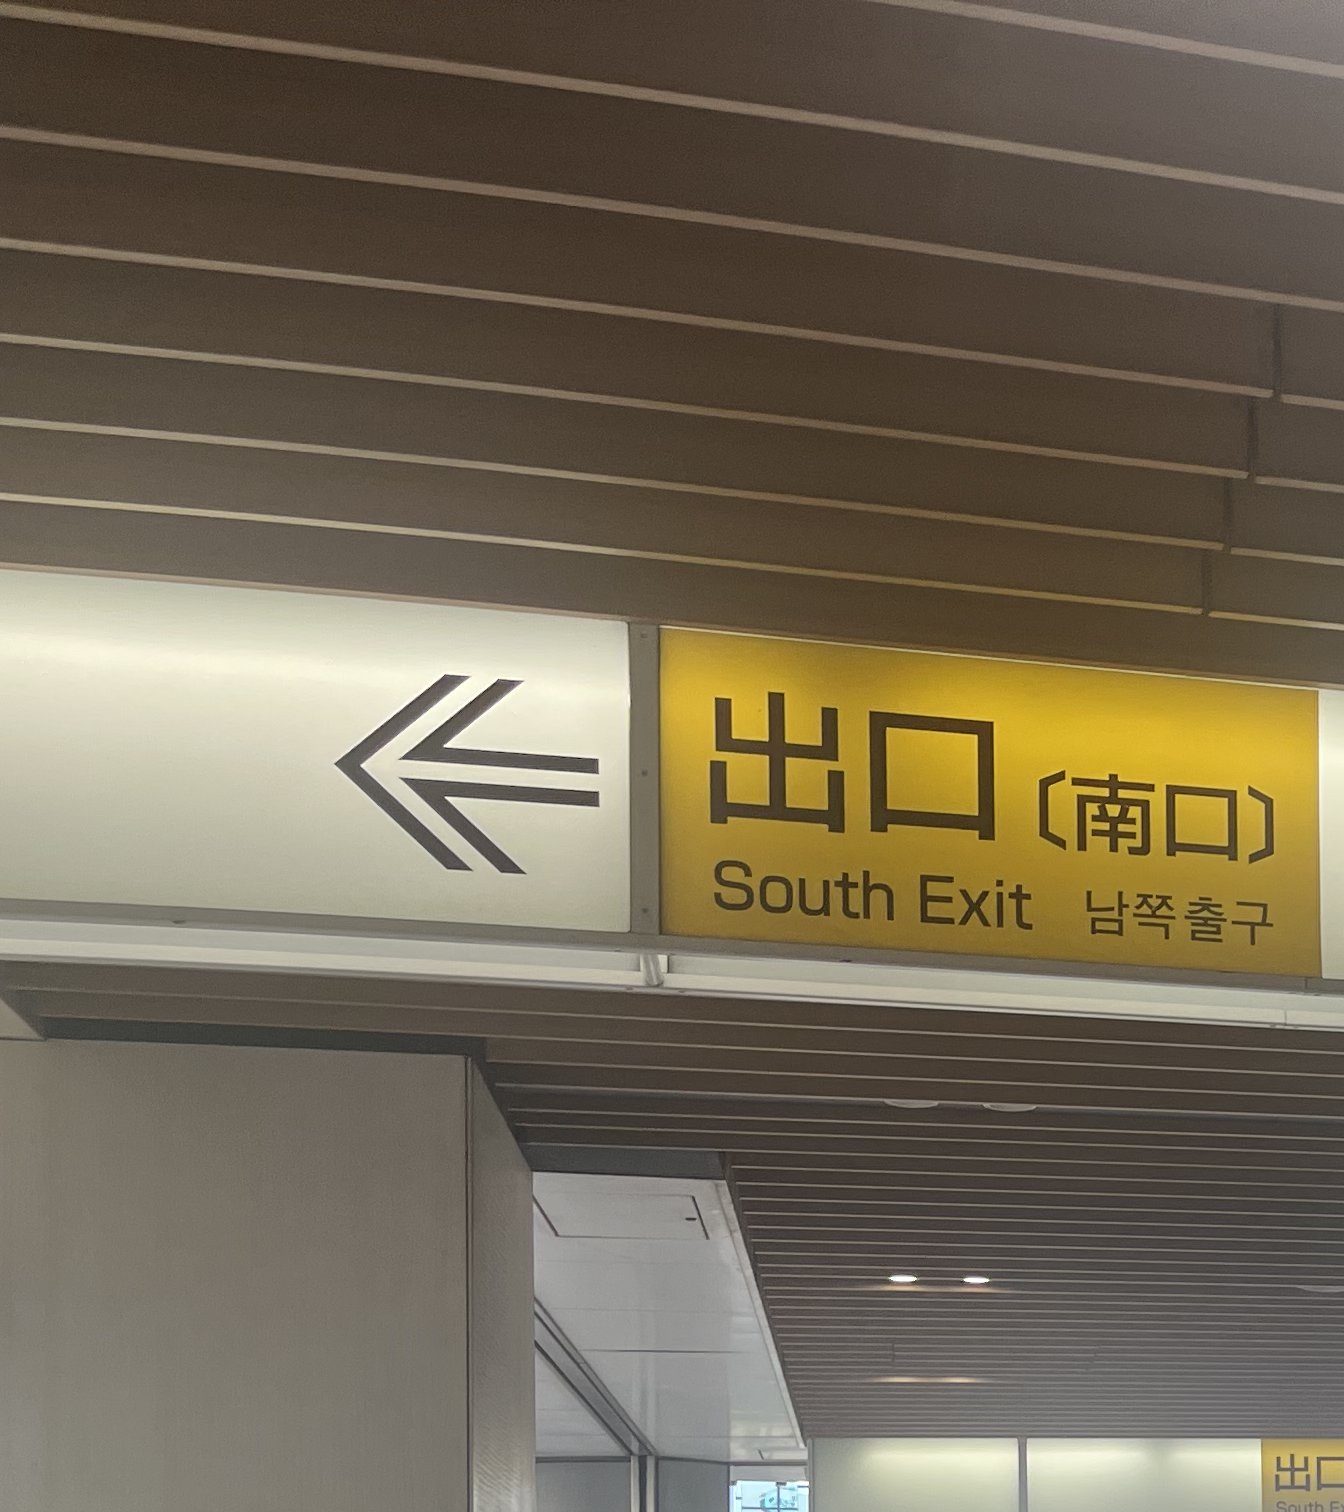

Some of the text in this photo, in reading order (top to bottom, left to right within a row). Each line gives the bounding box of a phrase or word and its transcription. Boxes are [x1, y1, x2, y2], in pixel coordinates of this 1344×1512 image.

[710, 692, 995, 841] 出口
[713, 860, 1033, 931] South Exit
